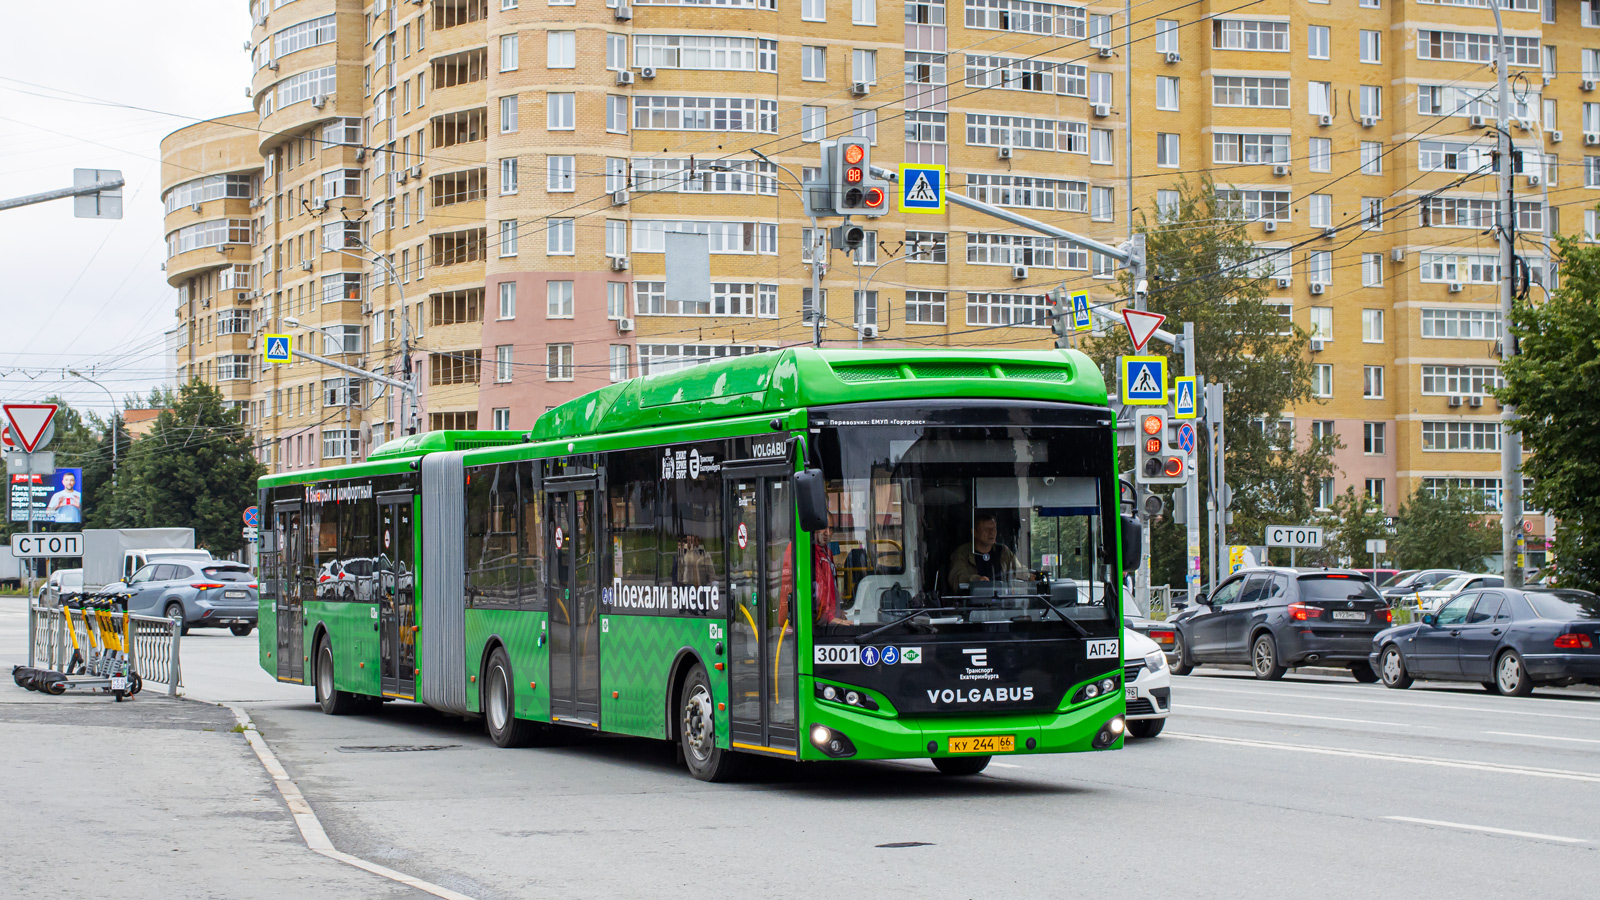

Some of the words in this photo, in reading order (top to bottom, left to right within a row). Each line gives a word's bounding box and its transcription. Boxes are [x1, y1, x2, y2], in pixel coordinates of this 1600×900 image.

[890, 418, 926, 426] «Гортранс»
[752, 441, 787, 457] VOLGABU
[333, 488, 337, 501] и
[1274, 530, 1316, 543] СТОП
[19, 537, 77, 553] СТОП
[613, 578, 668, 608] Поехали
[671, 585, 719, 610] вместе
[818, 647, 857, 662] 3001
[1089, 643, 1116, 656] АП-2
[927, 687, 1034, 704] VOLGABUS
[955, 741, 967, 750] КУ
[973, 739, 994, 750] 244
[1000, 738, 1011, 746] 66
